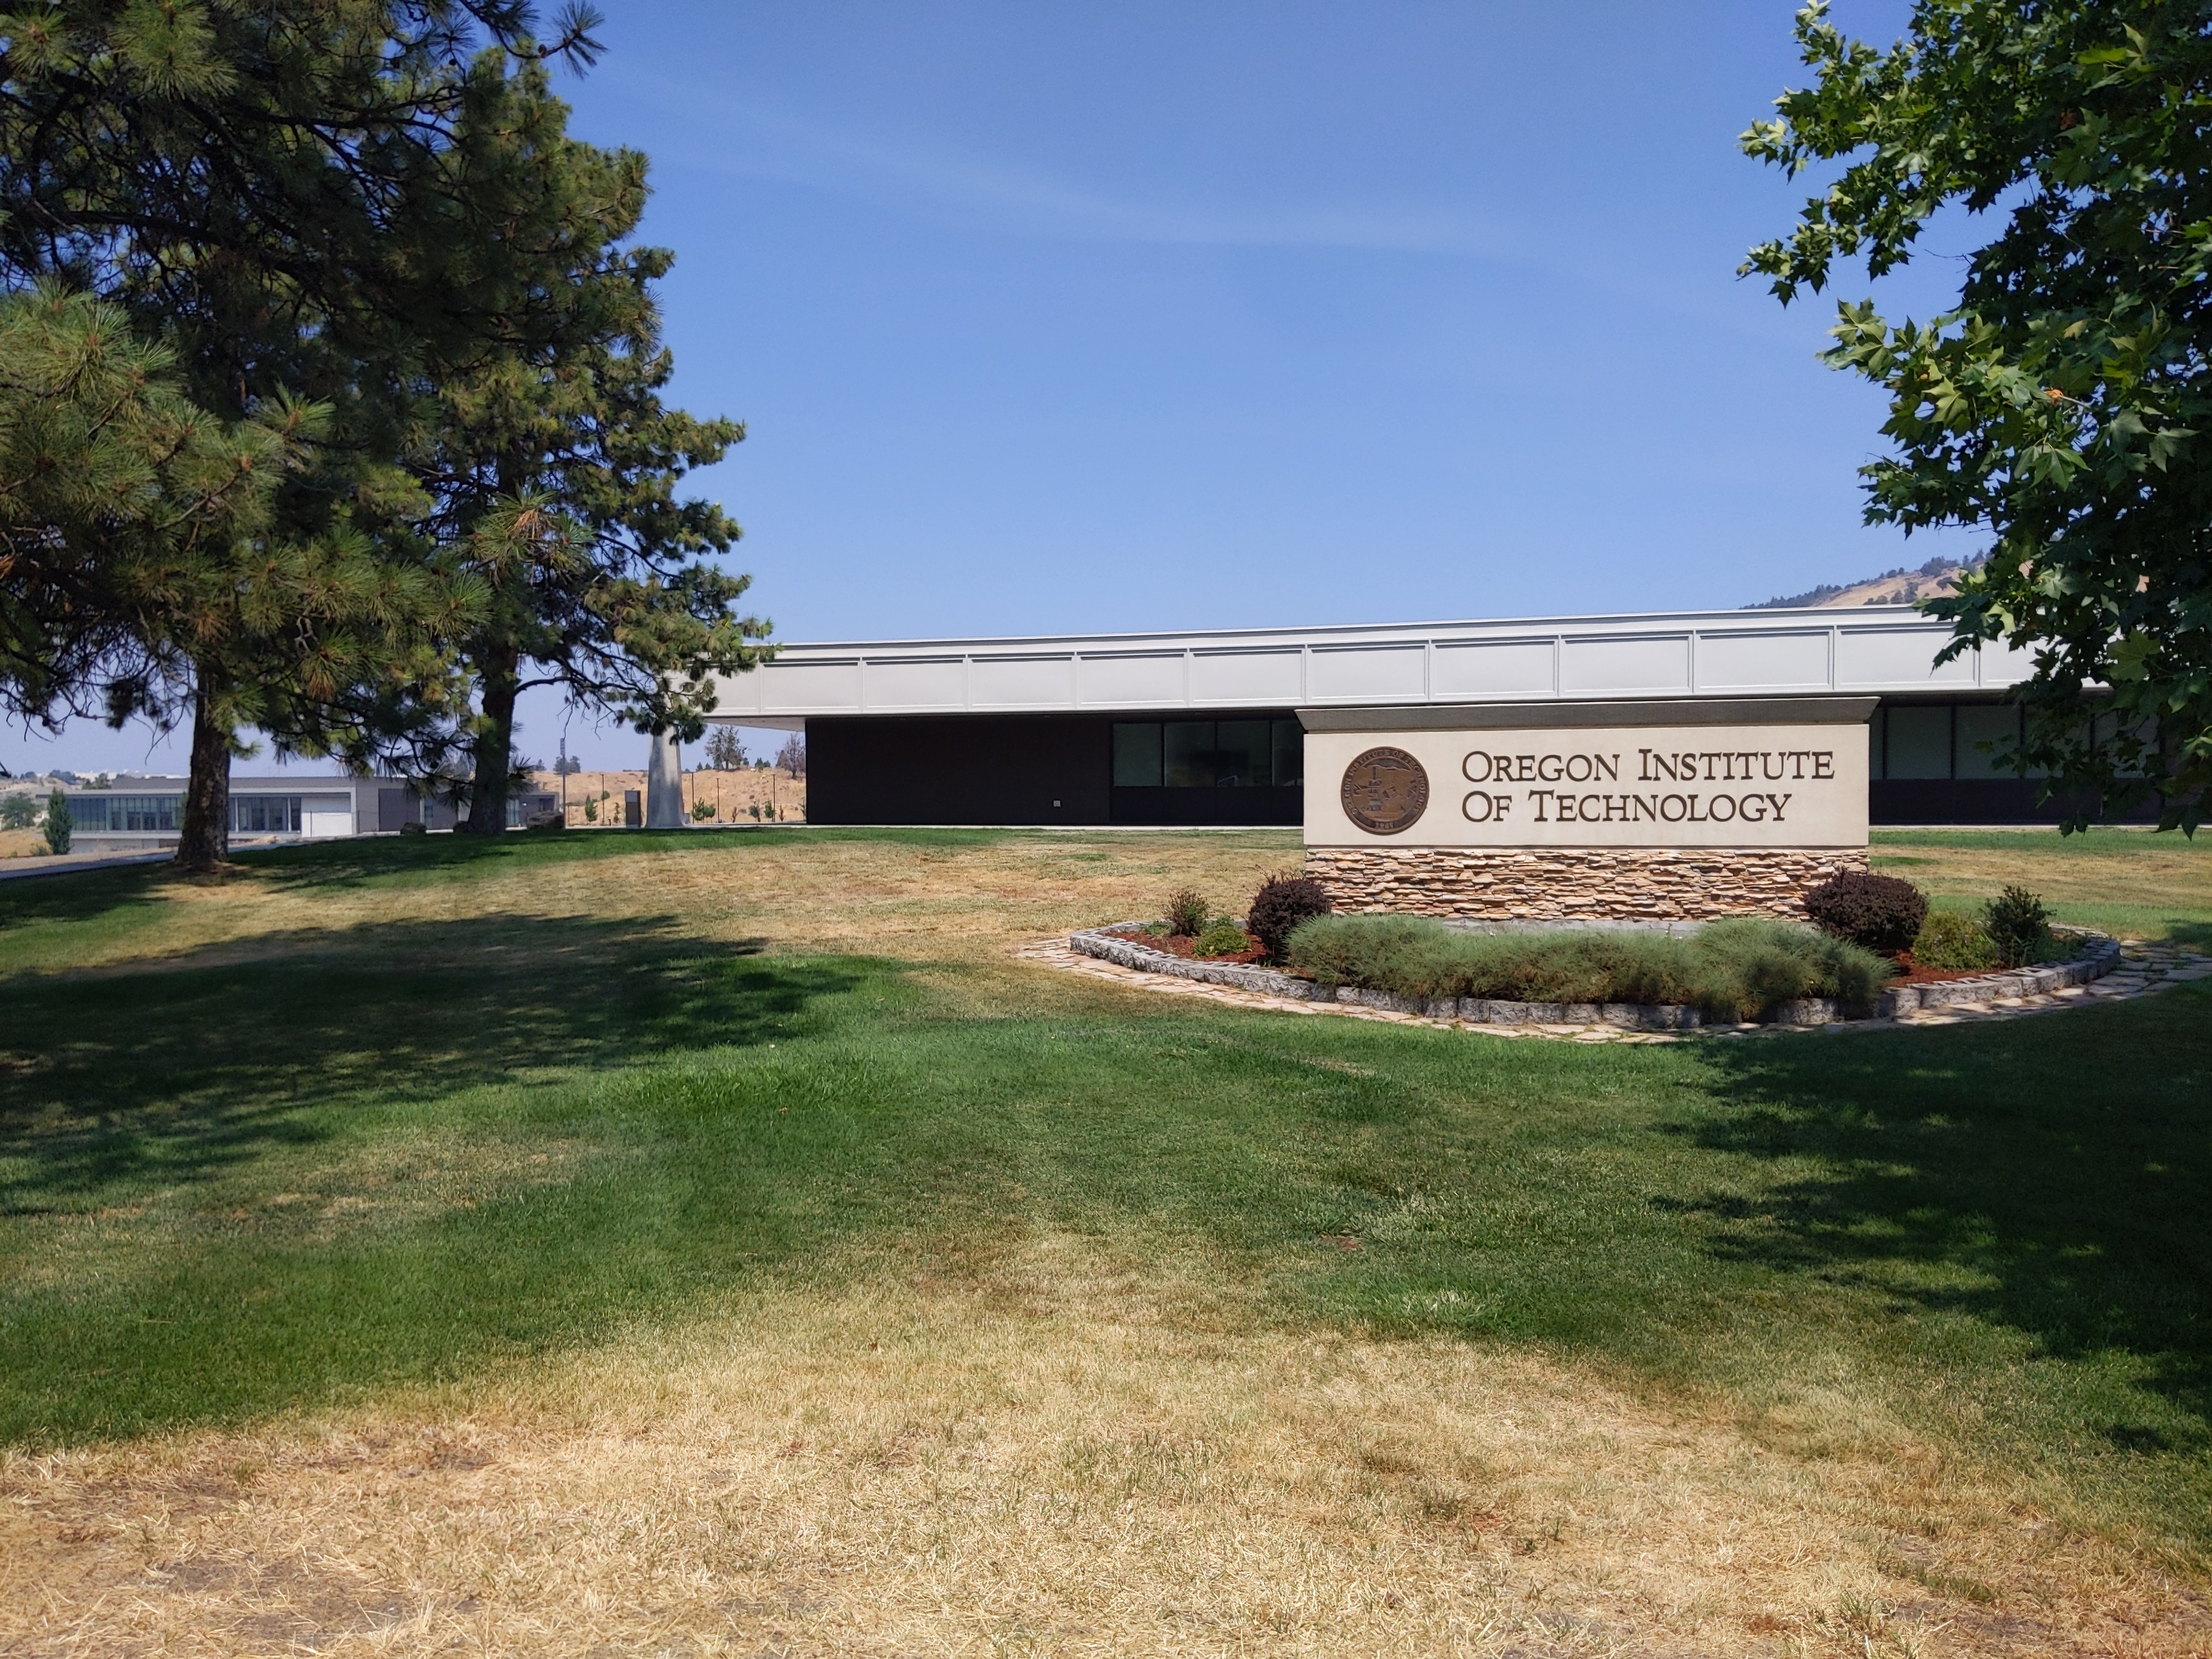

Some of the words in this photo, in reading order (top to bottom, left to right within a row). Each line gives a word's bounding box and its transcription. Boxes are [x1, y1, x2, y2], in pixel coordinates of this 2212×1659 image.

[1462, 751, 1620, 782] OREGON
[1638, 749, 1835, 782] INSTITUTE
[1462, 791, 1512, 822] OF
[1528, 789, 1792, 822] TECHNOLOGY
